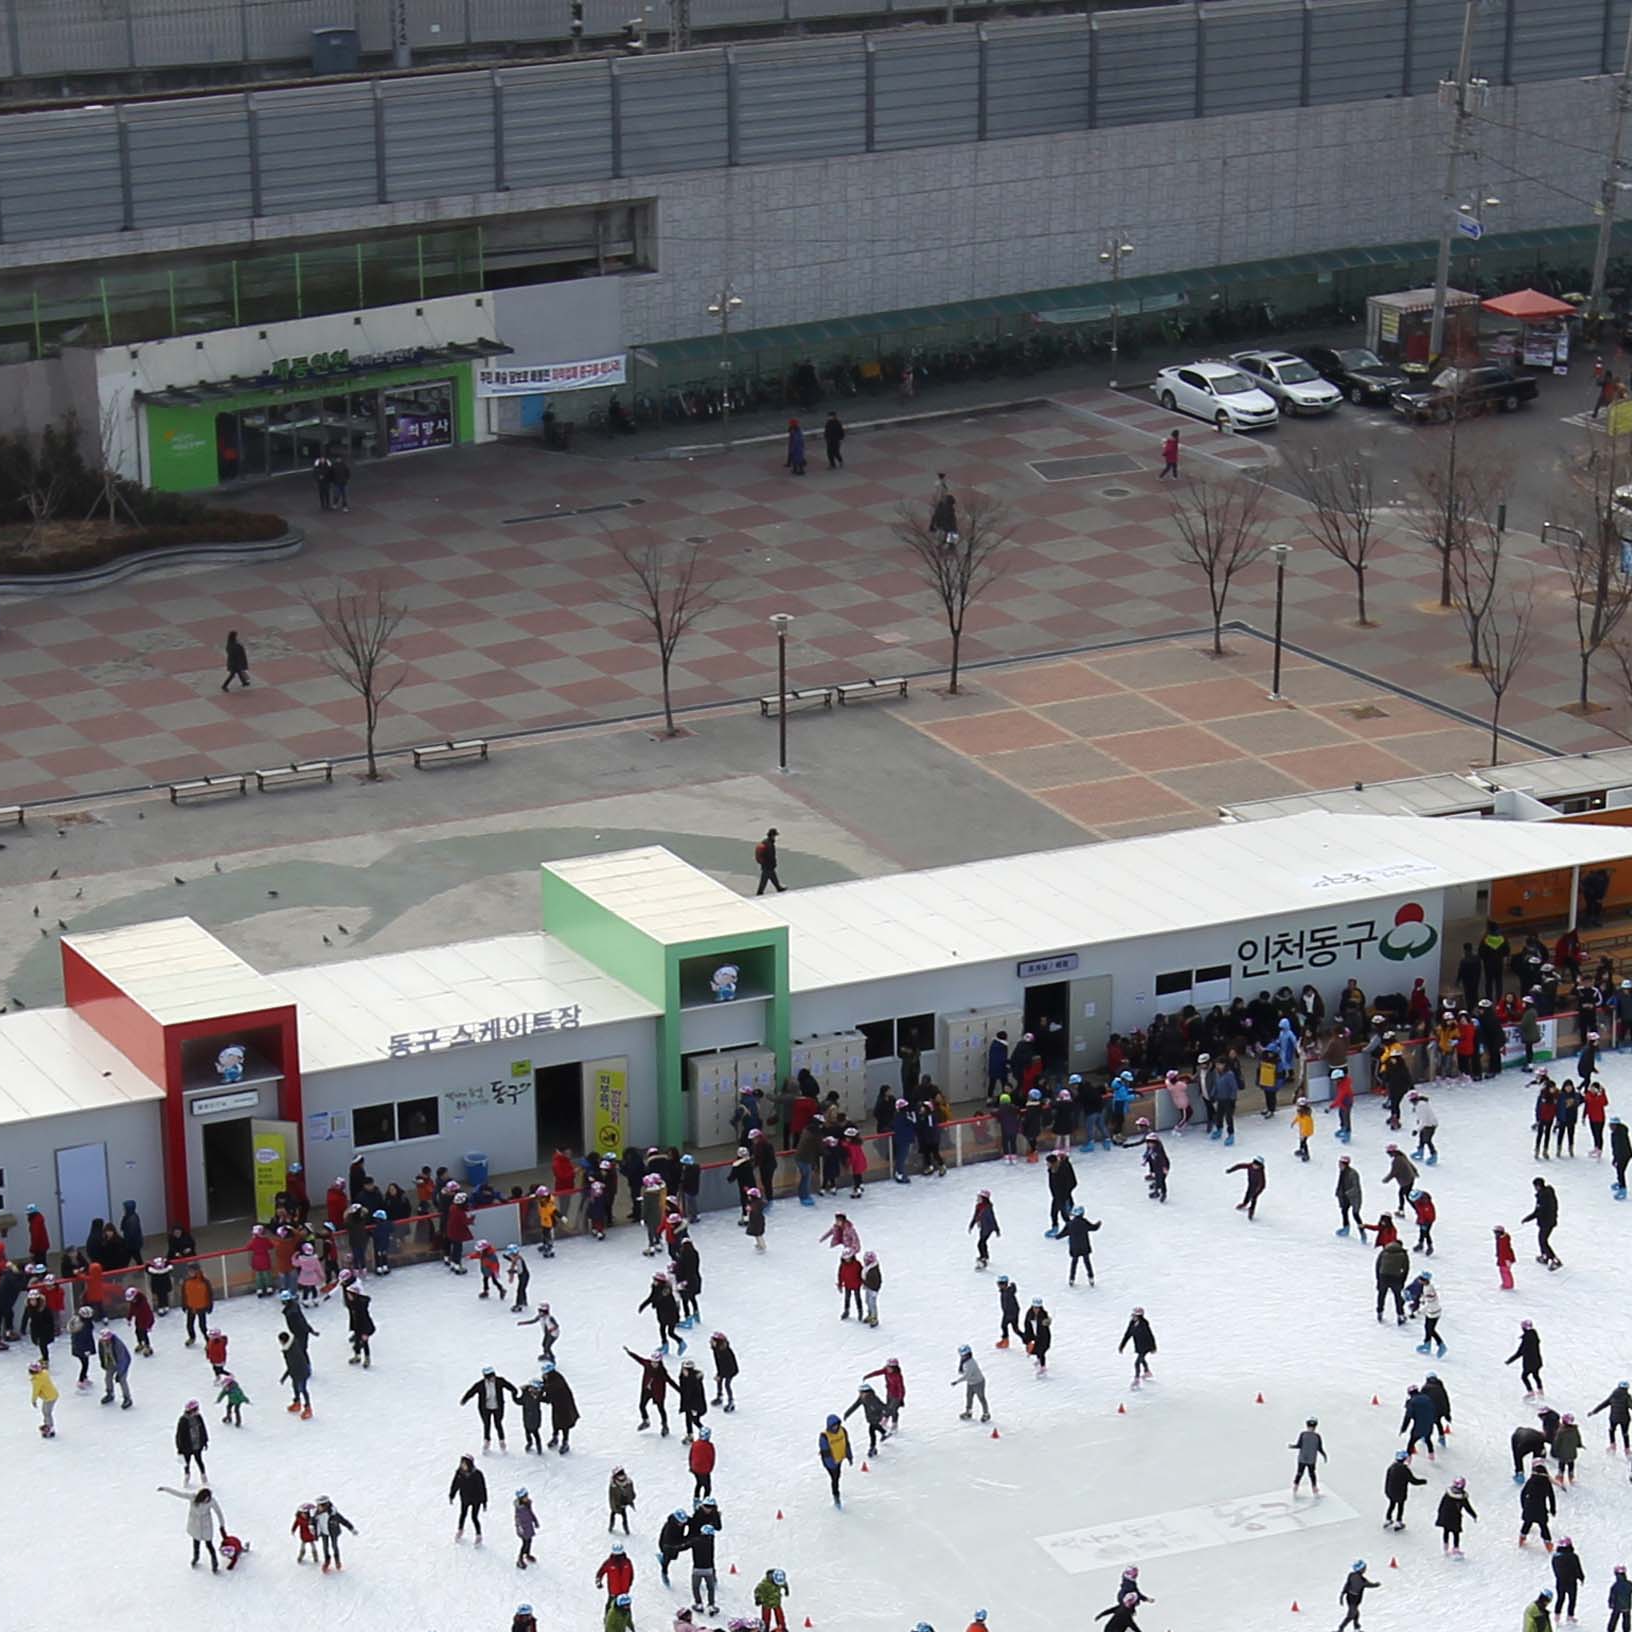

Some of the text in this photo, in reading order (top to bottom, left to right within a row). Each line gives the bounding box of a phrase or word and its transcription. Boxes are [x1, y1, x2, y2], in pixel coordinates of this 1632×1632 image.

[1237, 920, 1378, 979] 인천동구
[388, 1004, 581, 1060] 동구 스케이트장
